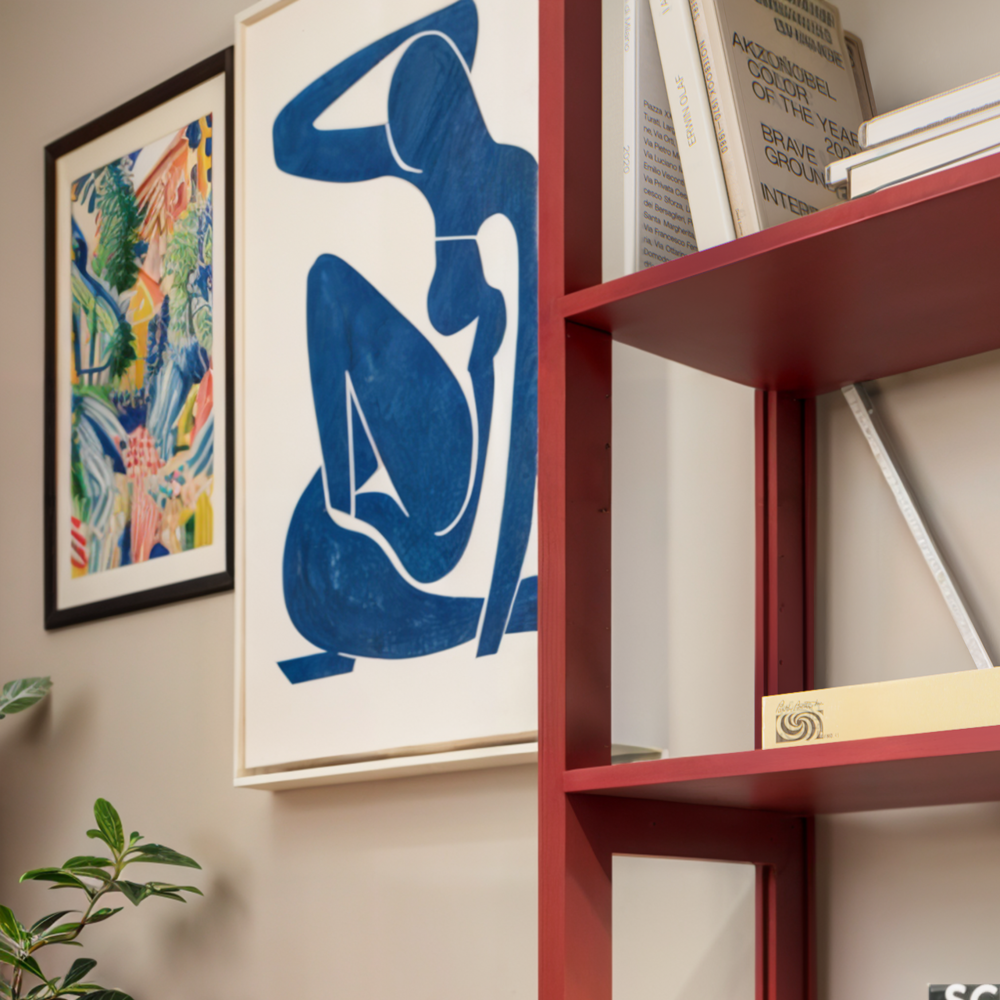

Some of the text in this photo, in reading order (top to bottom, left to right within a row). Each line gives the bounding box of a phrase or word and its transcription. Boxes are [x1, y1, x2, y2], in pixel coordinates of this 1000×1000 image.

[699, 39, 717, 98] NOTEBOOK
[674, 74, 688, 106] OLAF
[747, 58, 810, 106] COLOR
[751, 80, 775, 104] OF
[779, 92, 815, 128] THE
[653, 128, 663, 141] Via
[682, 106, 697, 148] ERWIN
[643, 136, 653, 149] Via
[643, 148, 654, 160] Via
[760, 122, 818, 167] BRAVE
[643, 173, 653, 185] Via
[643, 210, 661, 226] Santa
[643, 222, 653, 234] Via
[654, 227, 685, 248] Francesco
[654, 239, 664, 251] Via
